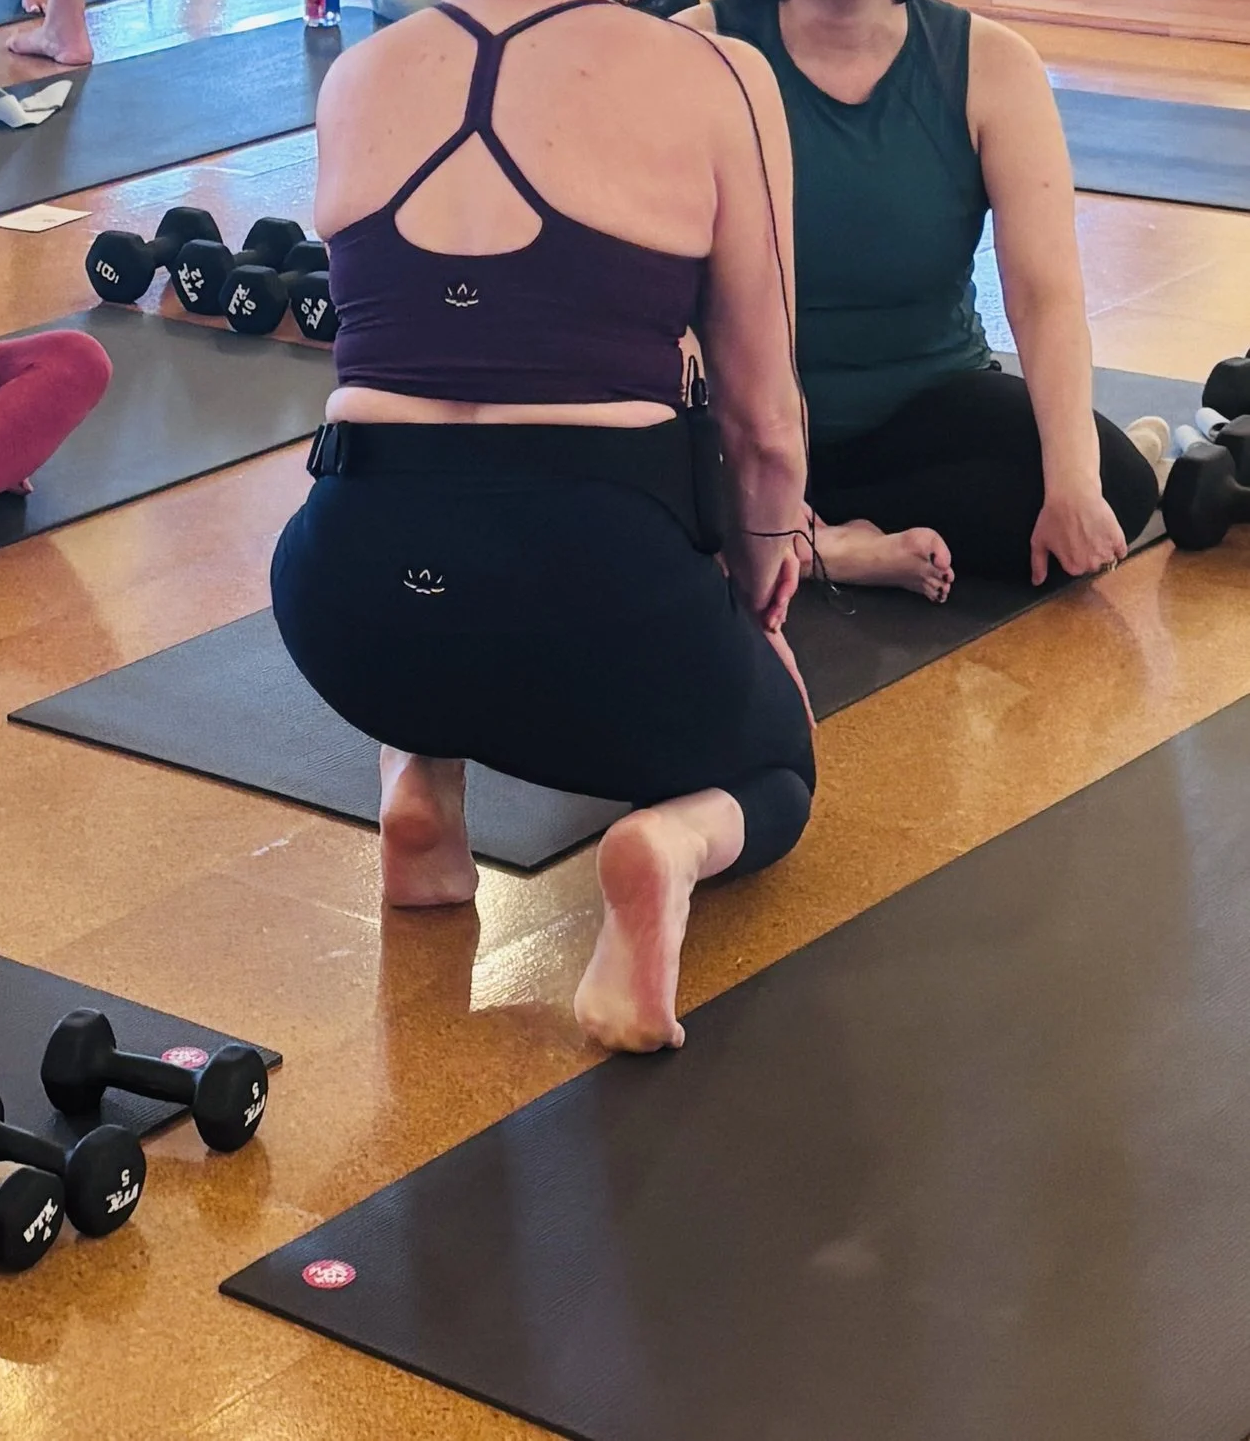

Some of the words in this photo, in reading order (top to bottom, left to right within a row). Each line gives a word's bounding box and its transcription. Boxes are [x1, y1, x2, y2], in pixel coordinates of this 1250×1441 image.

[191, 268, 205, 289] 12
[228, 284, 250, 315] VTX
[241, 299, 256, 315] 10
[300, 297, 312, 314] 10
[252, 1081, 259, 1100] 5
[121, 1168, 130, 1187] 5
[106, 1182, 139, 1213] VTX
[23, 1198, 58, 1243] VTX
